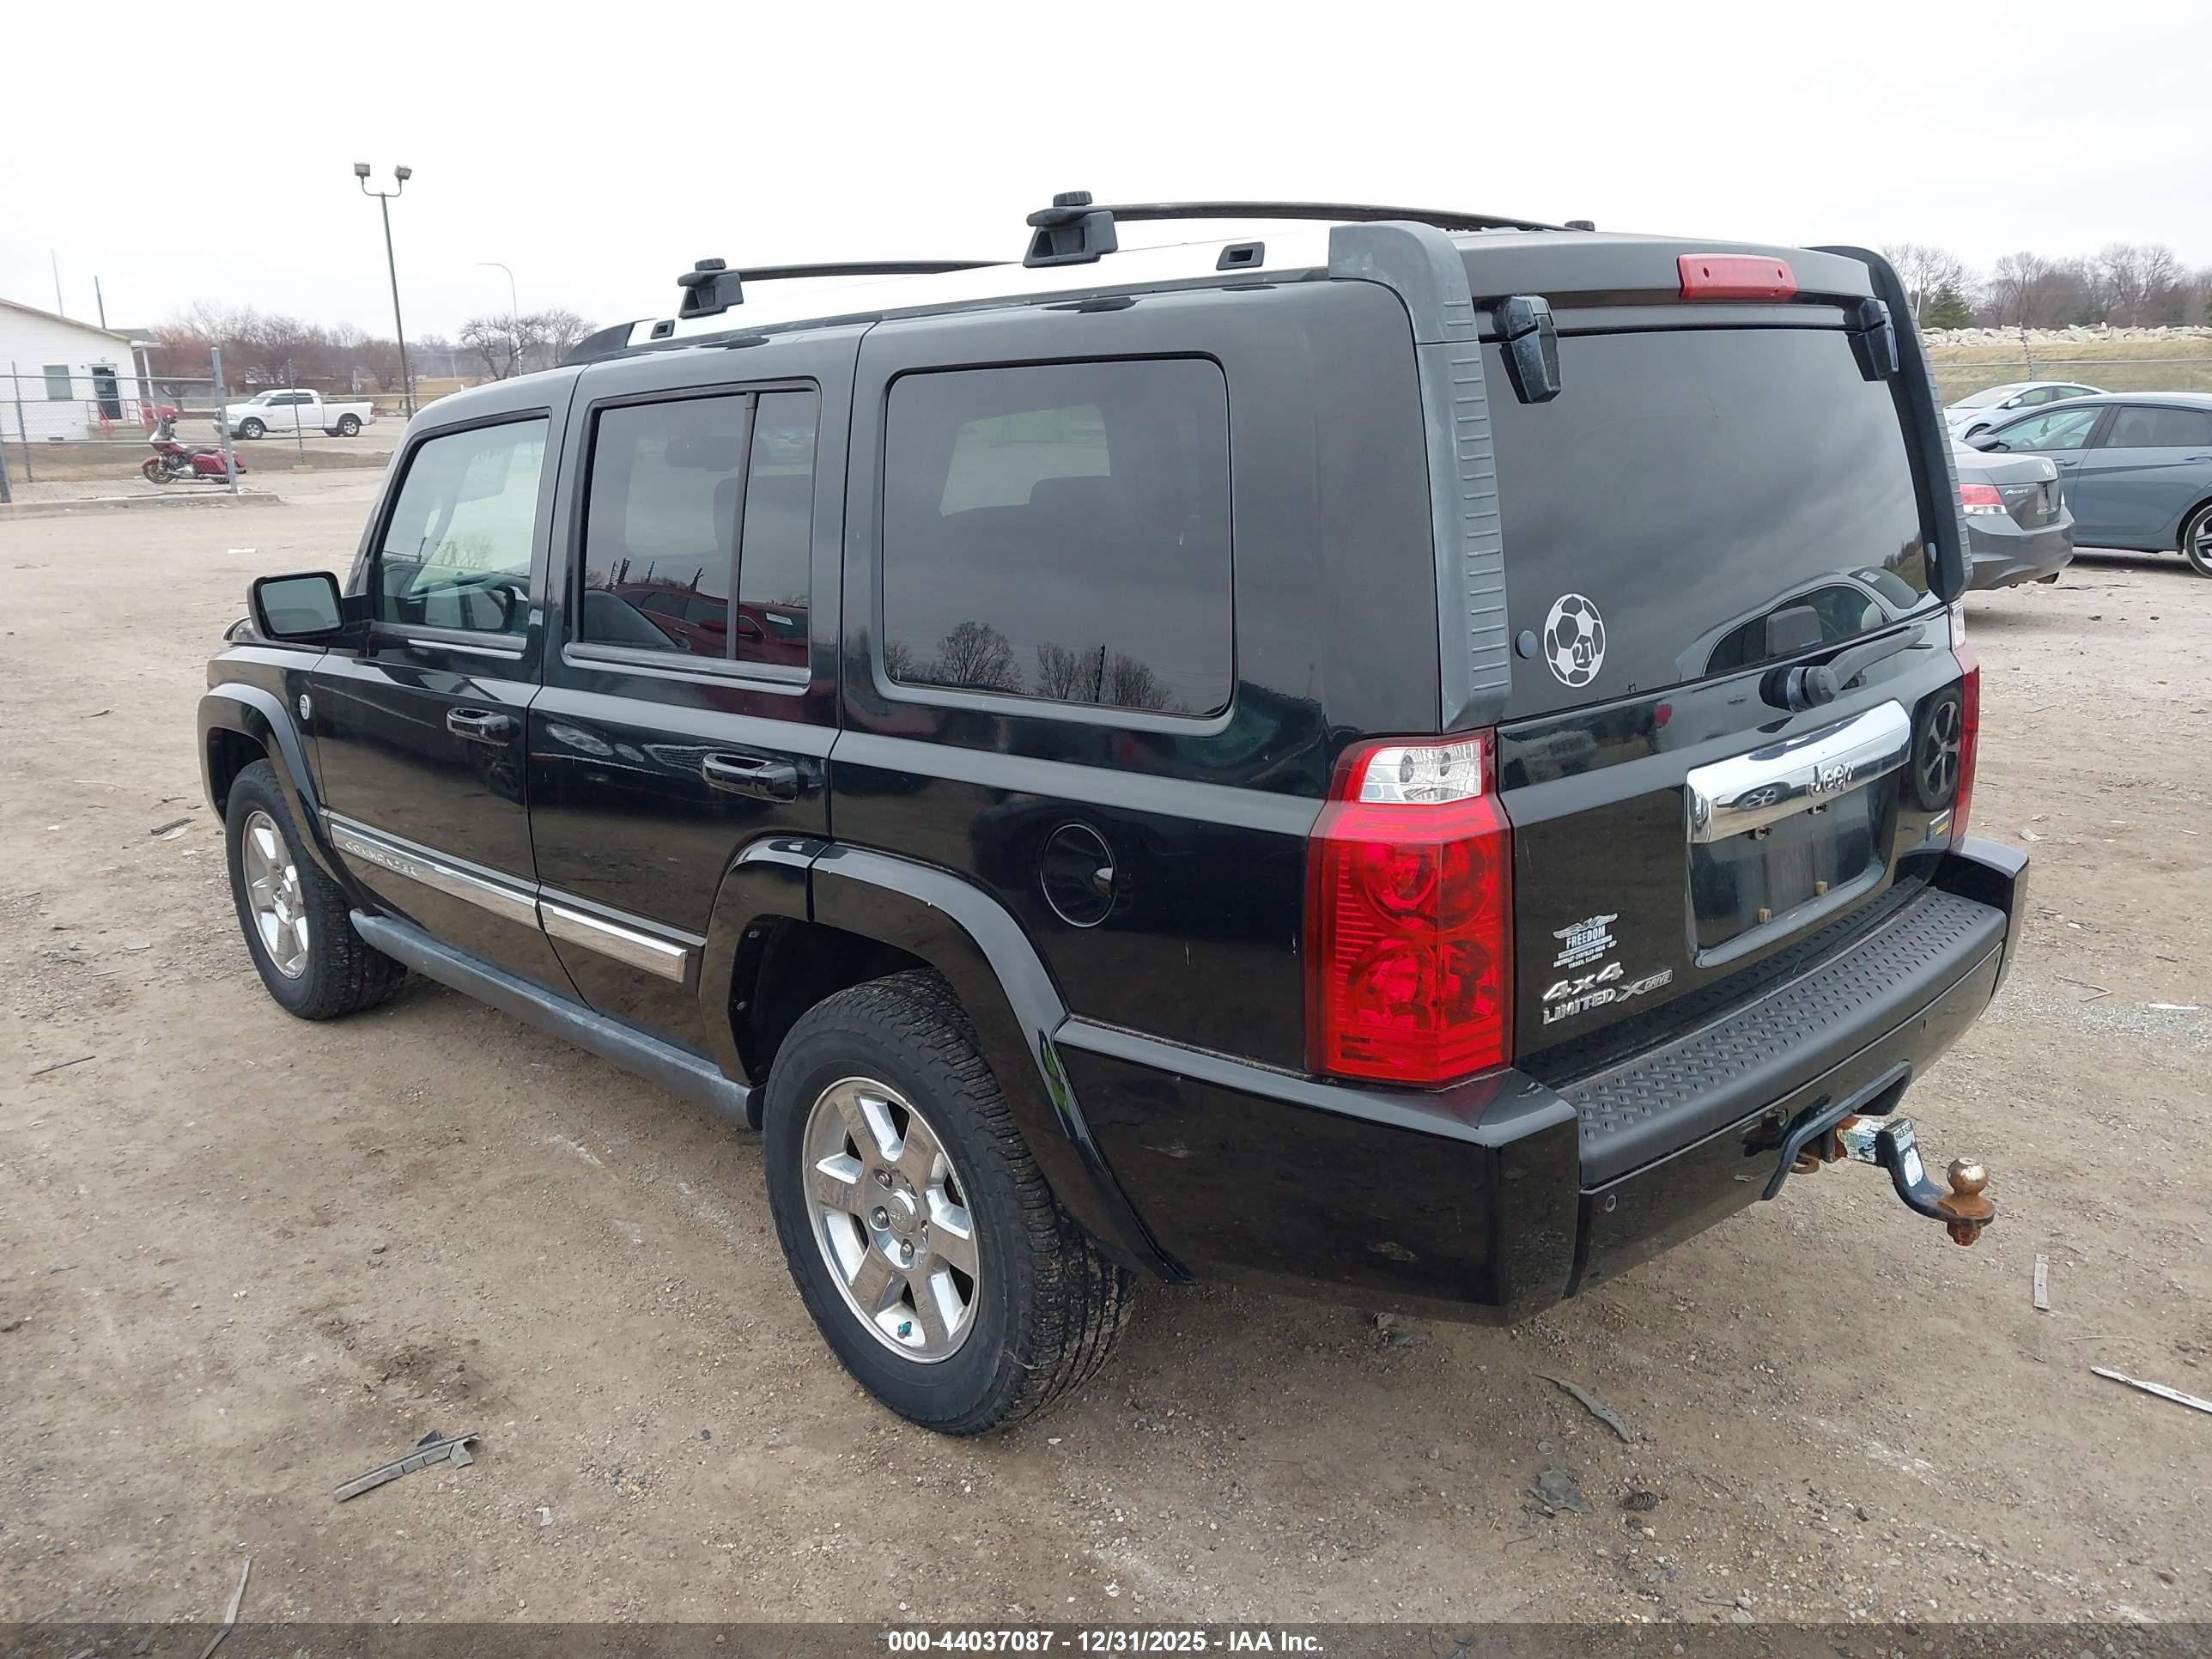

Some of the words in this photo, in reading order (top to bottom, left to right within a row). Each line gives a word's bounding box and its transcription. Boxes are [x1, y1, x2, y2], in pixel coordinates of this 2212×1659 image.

[1574, 641, 1593, 664] 21
[1810, 762, 1855, 793] Jeep
[345, 841, 418, 877] COMMANDER
[1566, 925, 1606, 950] FREEDOM
[1543, 988, 1616, 1024] LIMITED
